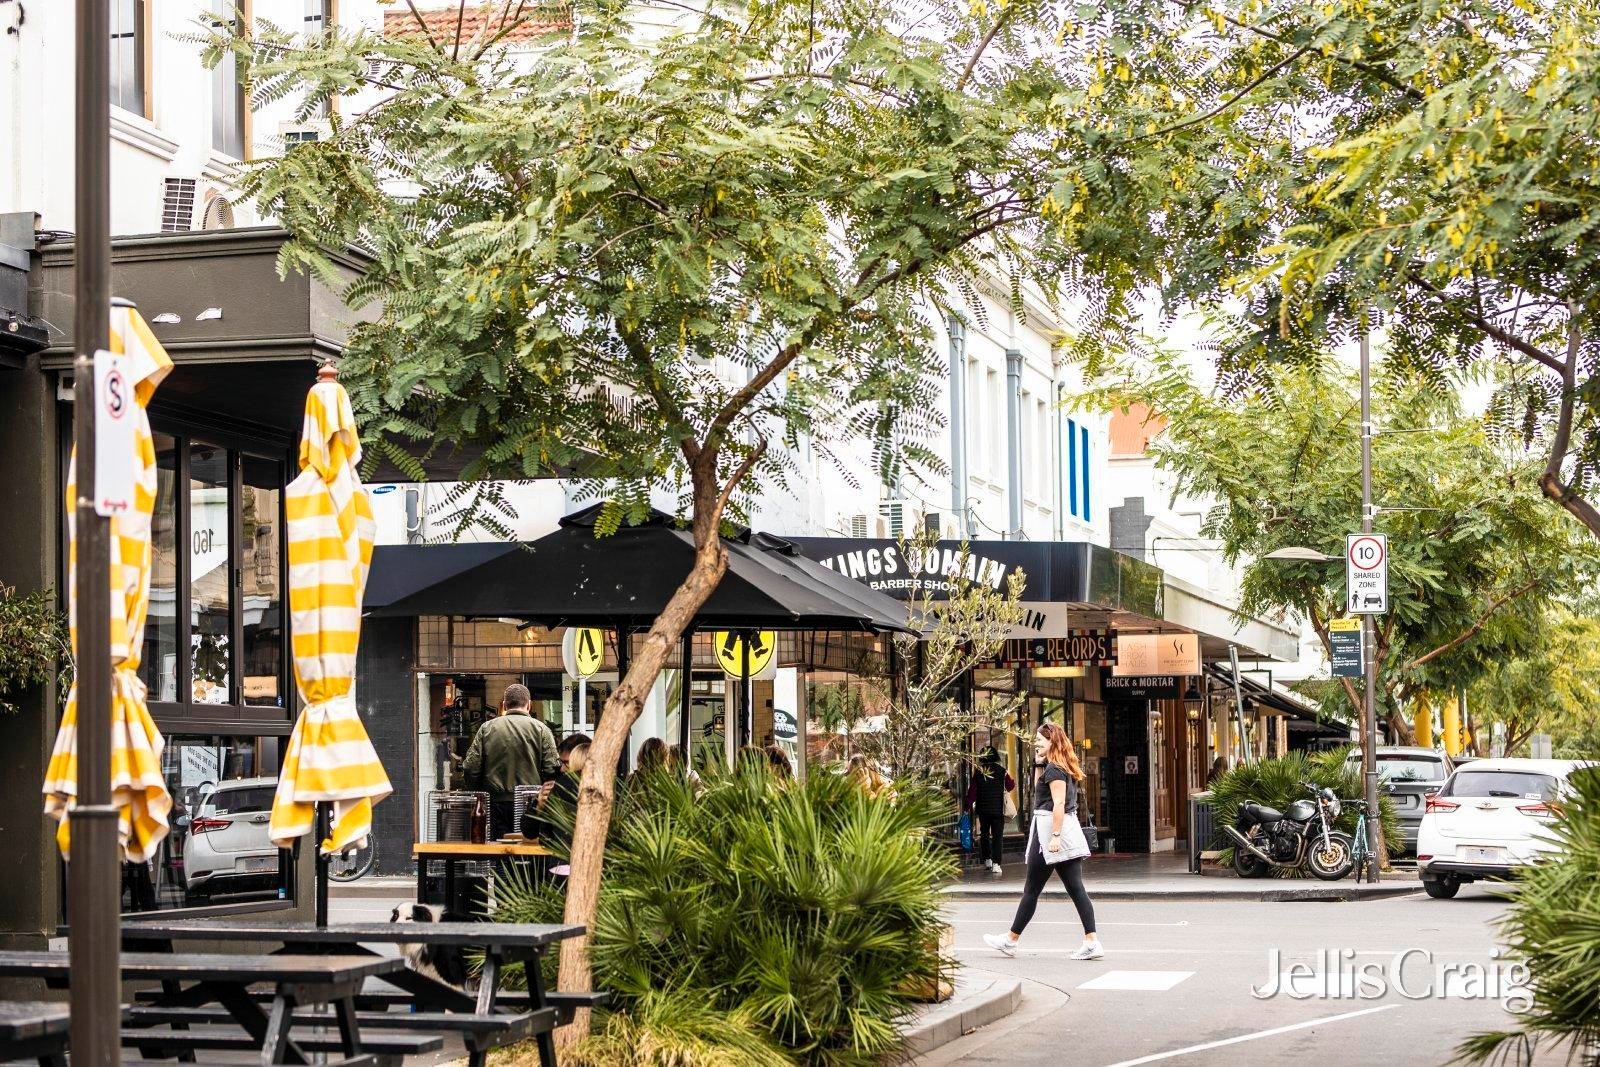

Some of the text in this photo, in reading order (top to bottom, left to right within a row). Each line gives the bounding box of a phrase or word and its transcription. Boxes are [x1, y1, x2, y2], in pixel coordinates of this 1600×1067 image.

[1359, 546, 1375, 560] 10
[870, 579, 922, 590] BARBER
[996, 637, 1106, 661] VILLE RECORDS
[1106, 678, 1130, 687] BRICK
[1140, 677, 1174, 687] MORTAR
